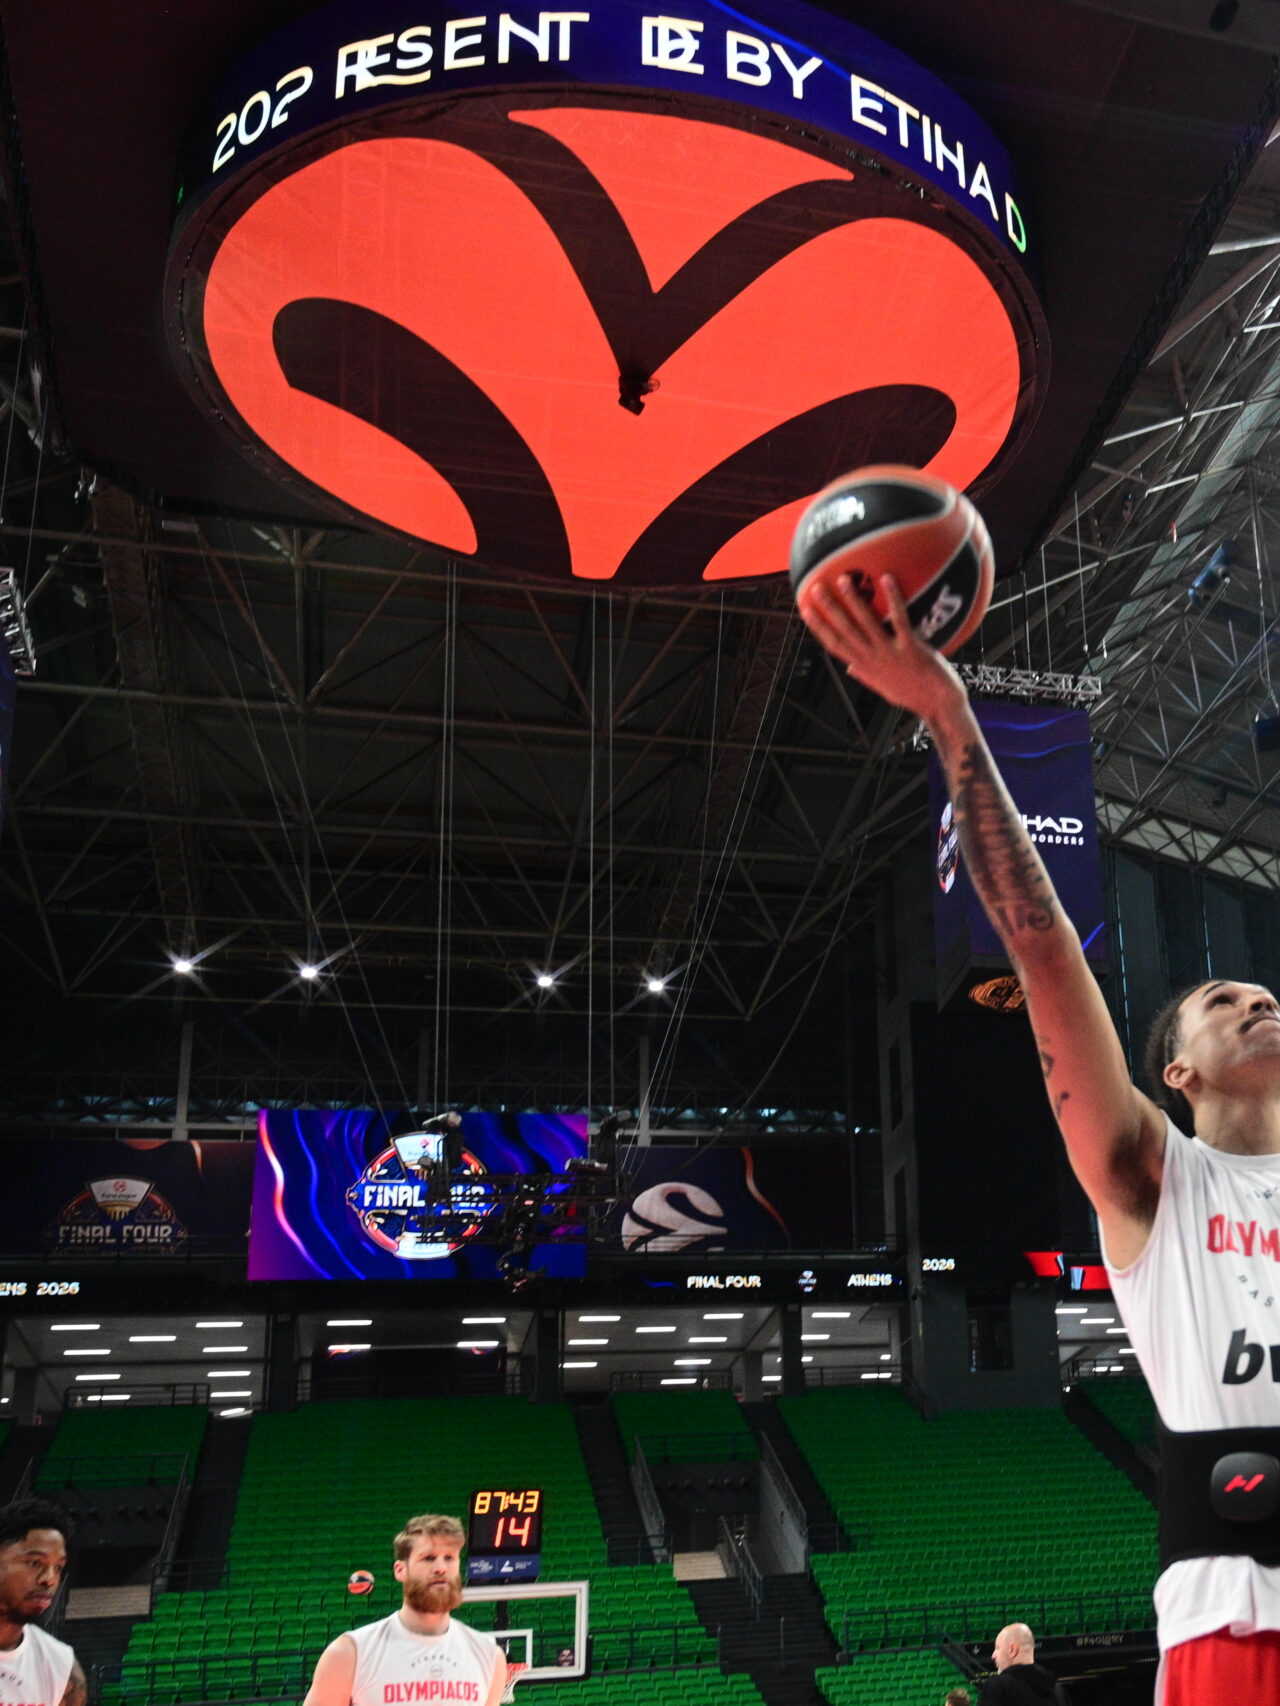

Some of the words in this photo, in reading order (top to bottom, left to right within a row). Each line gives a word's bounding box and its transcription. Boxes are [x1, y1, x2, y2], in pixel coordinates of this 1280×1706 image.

[726, 30, 824, 100] BY
[851, 74, 1027, 253] ETIHAD
[363, 1185, 426, 1207] FINAL
[59, 1225, 117, 1243] FINAL
[122, 1225, 172, 1243] FOUR
[922, 1258, 955, 1271] 2026
[36, 1282, 80, 1296] 2026
[687, 1275, 724, 1289] FINAL
[725, 1274, 762, 1289] FOUR
[847, 1273, 892, 1287] ATHENS
[494, 1516, 532, 1548] 14
[384, 1679, 479, 1704] OLYMPIACOS
